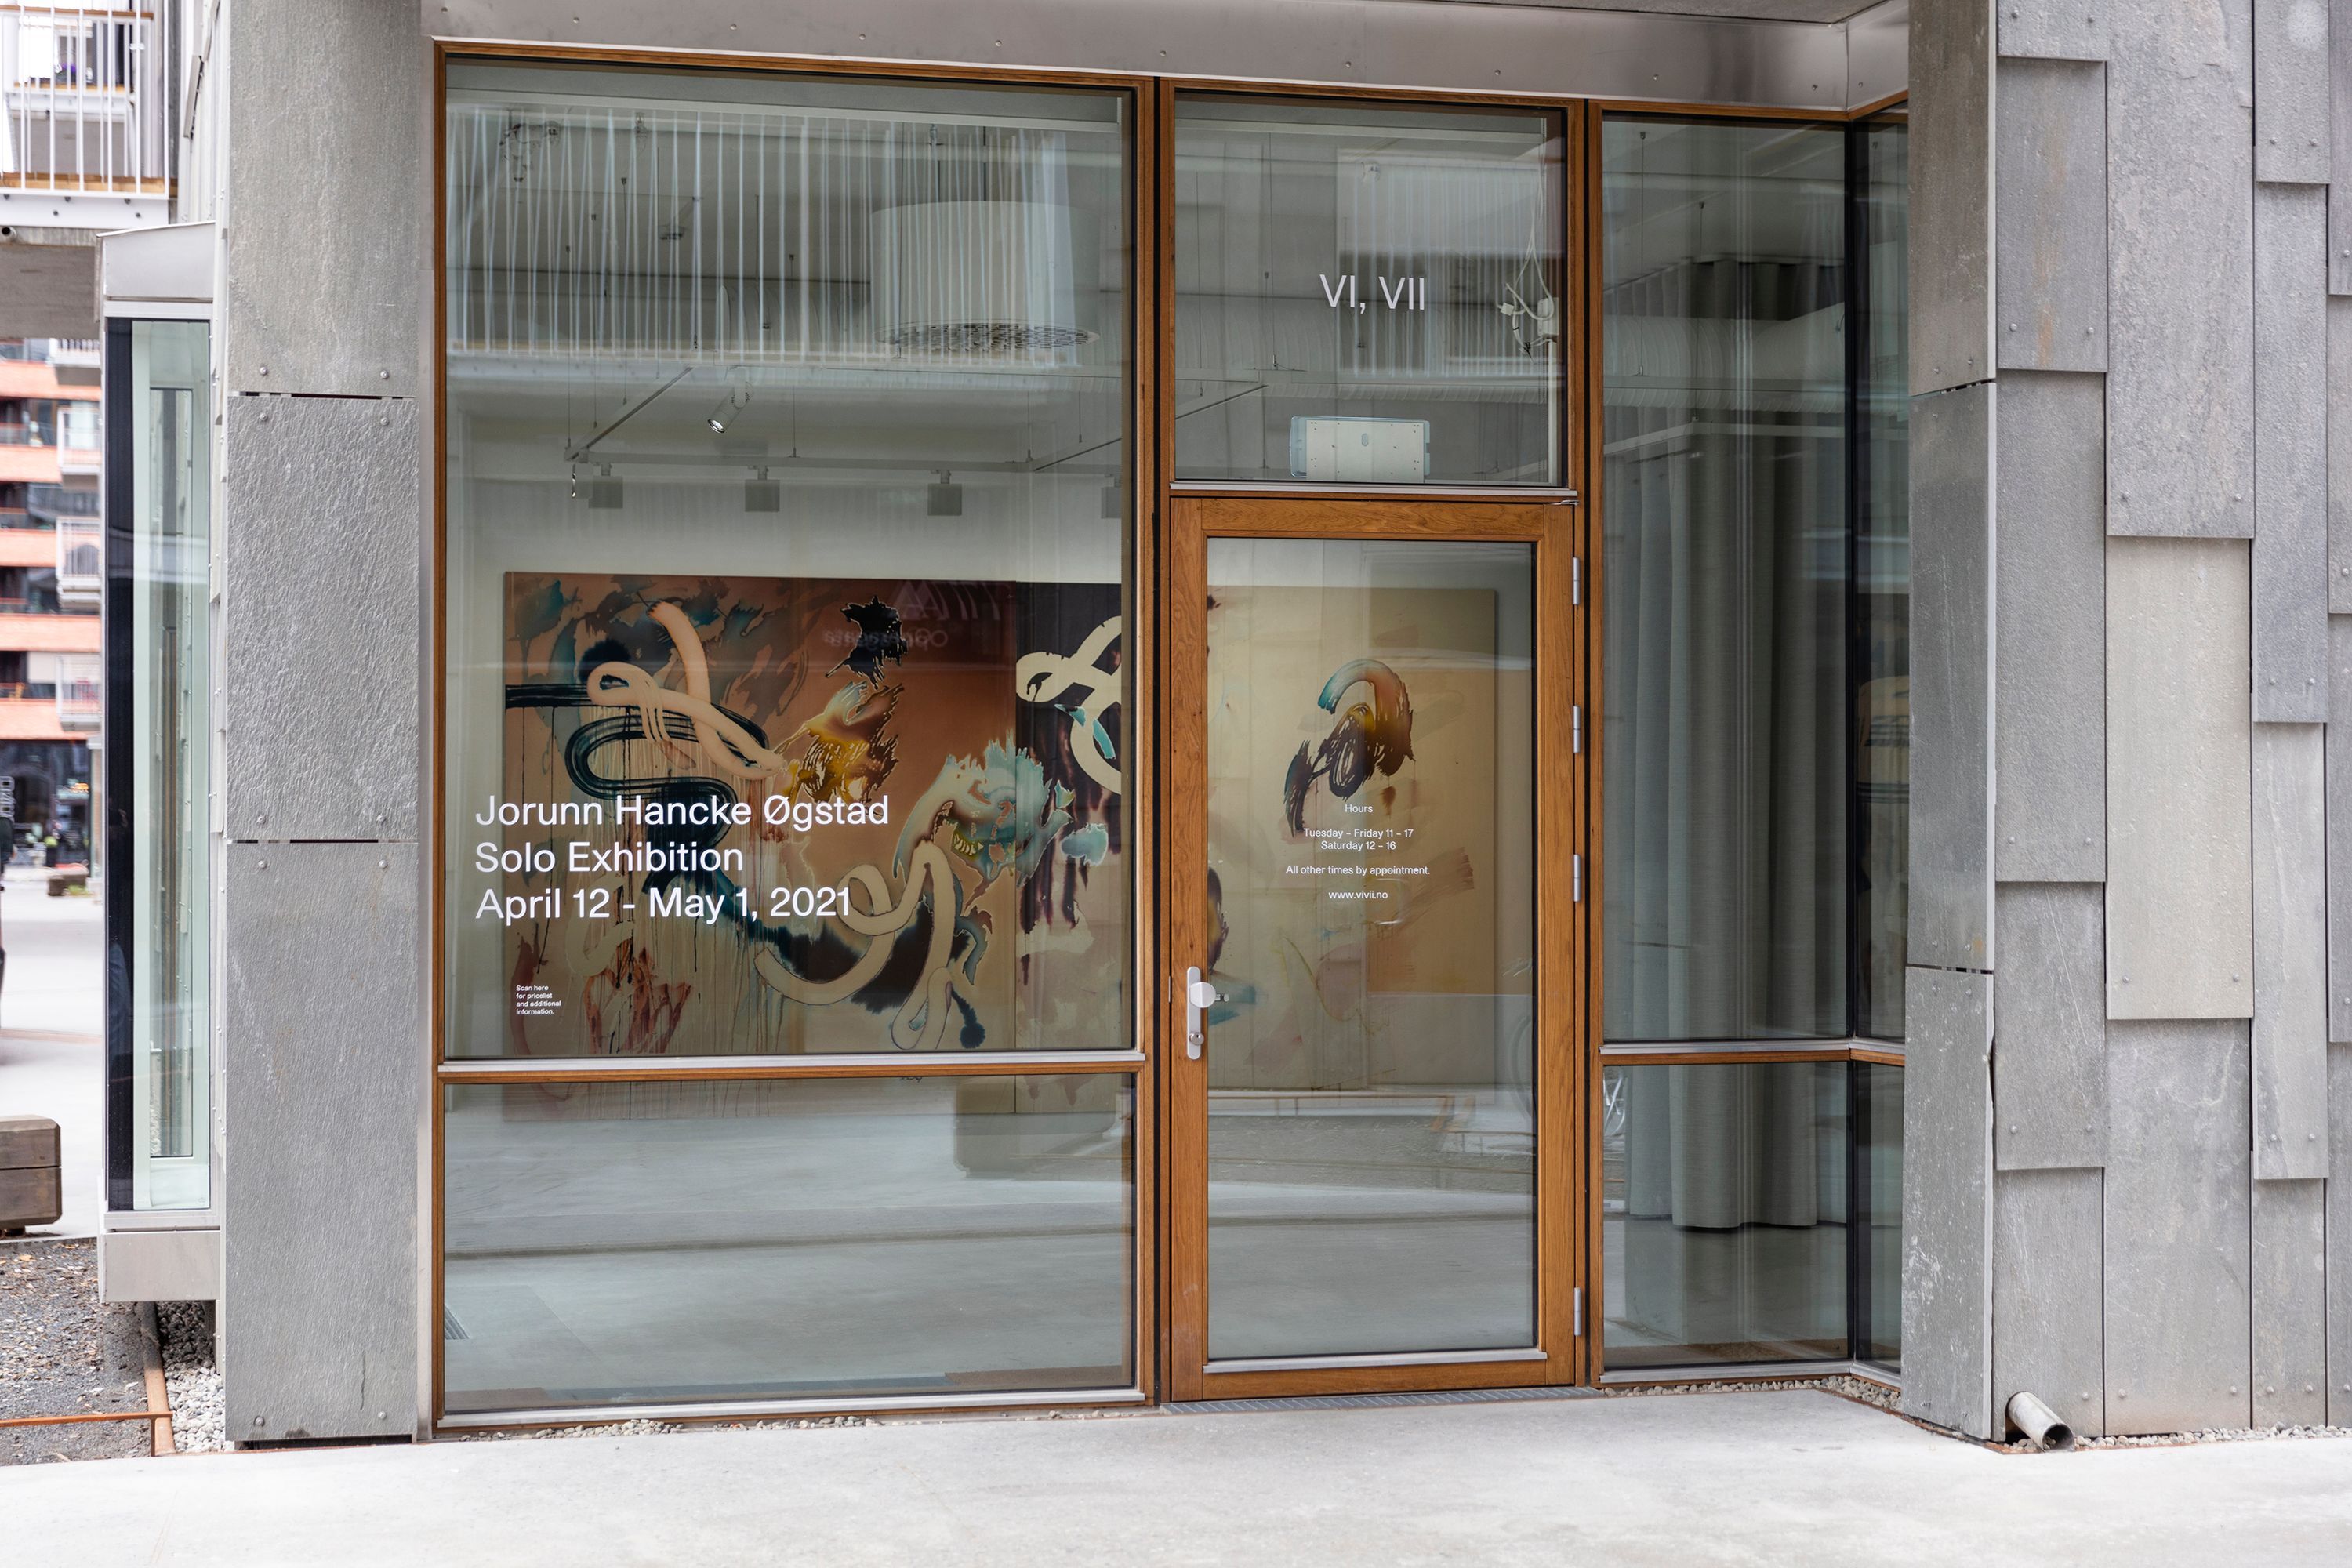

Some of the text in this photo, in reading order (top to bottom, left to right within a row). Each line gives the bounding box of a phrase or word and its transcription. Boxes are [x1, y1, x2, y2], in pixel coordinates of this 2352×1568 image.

[1319, 274, 1425, 314] VI, VII
[475, 794, 889, 832] Jorunn Hancke Øgstad
[1345, 804, 1374, 813] Hours
[1304, 828, 1344, 840] Tuesday
[1354, 828, 1384, 840] Friday
[1385, 829, 1393, 837] 11
[1404, 829, 1414, 837] 17
[1321, 840, 1363, 851] Saturday
[1366, 841, 1376, 850] 12
[1386, 841, 1396, 850] 16
[475, 841, 743, 873] Solo Exhibition
[1286, 866, 1430, 877] All other times by appointment.
[1328, 890, 1388, 899] www.vivii.no
[475, 887, 561, 927] April
[572, 887, 610, 918] 12
[649, 887, 725, 925] May
[735, 887, 758, 922] 1,
[770, 887, 849, 917] 2021
